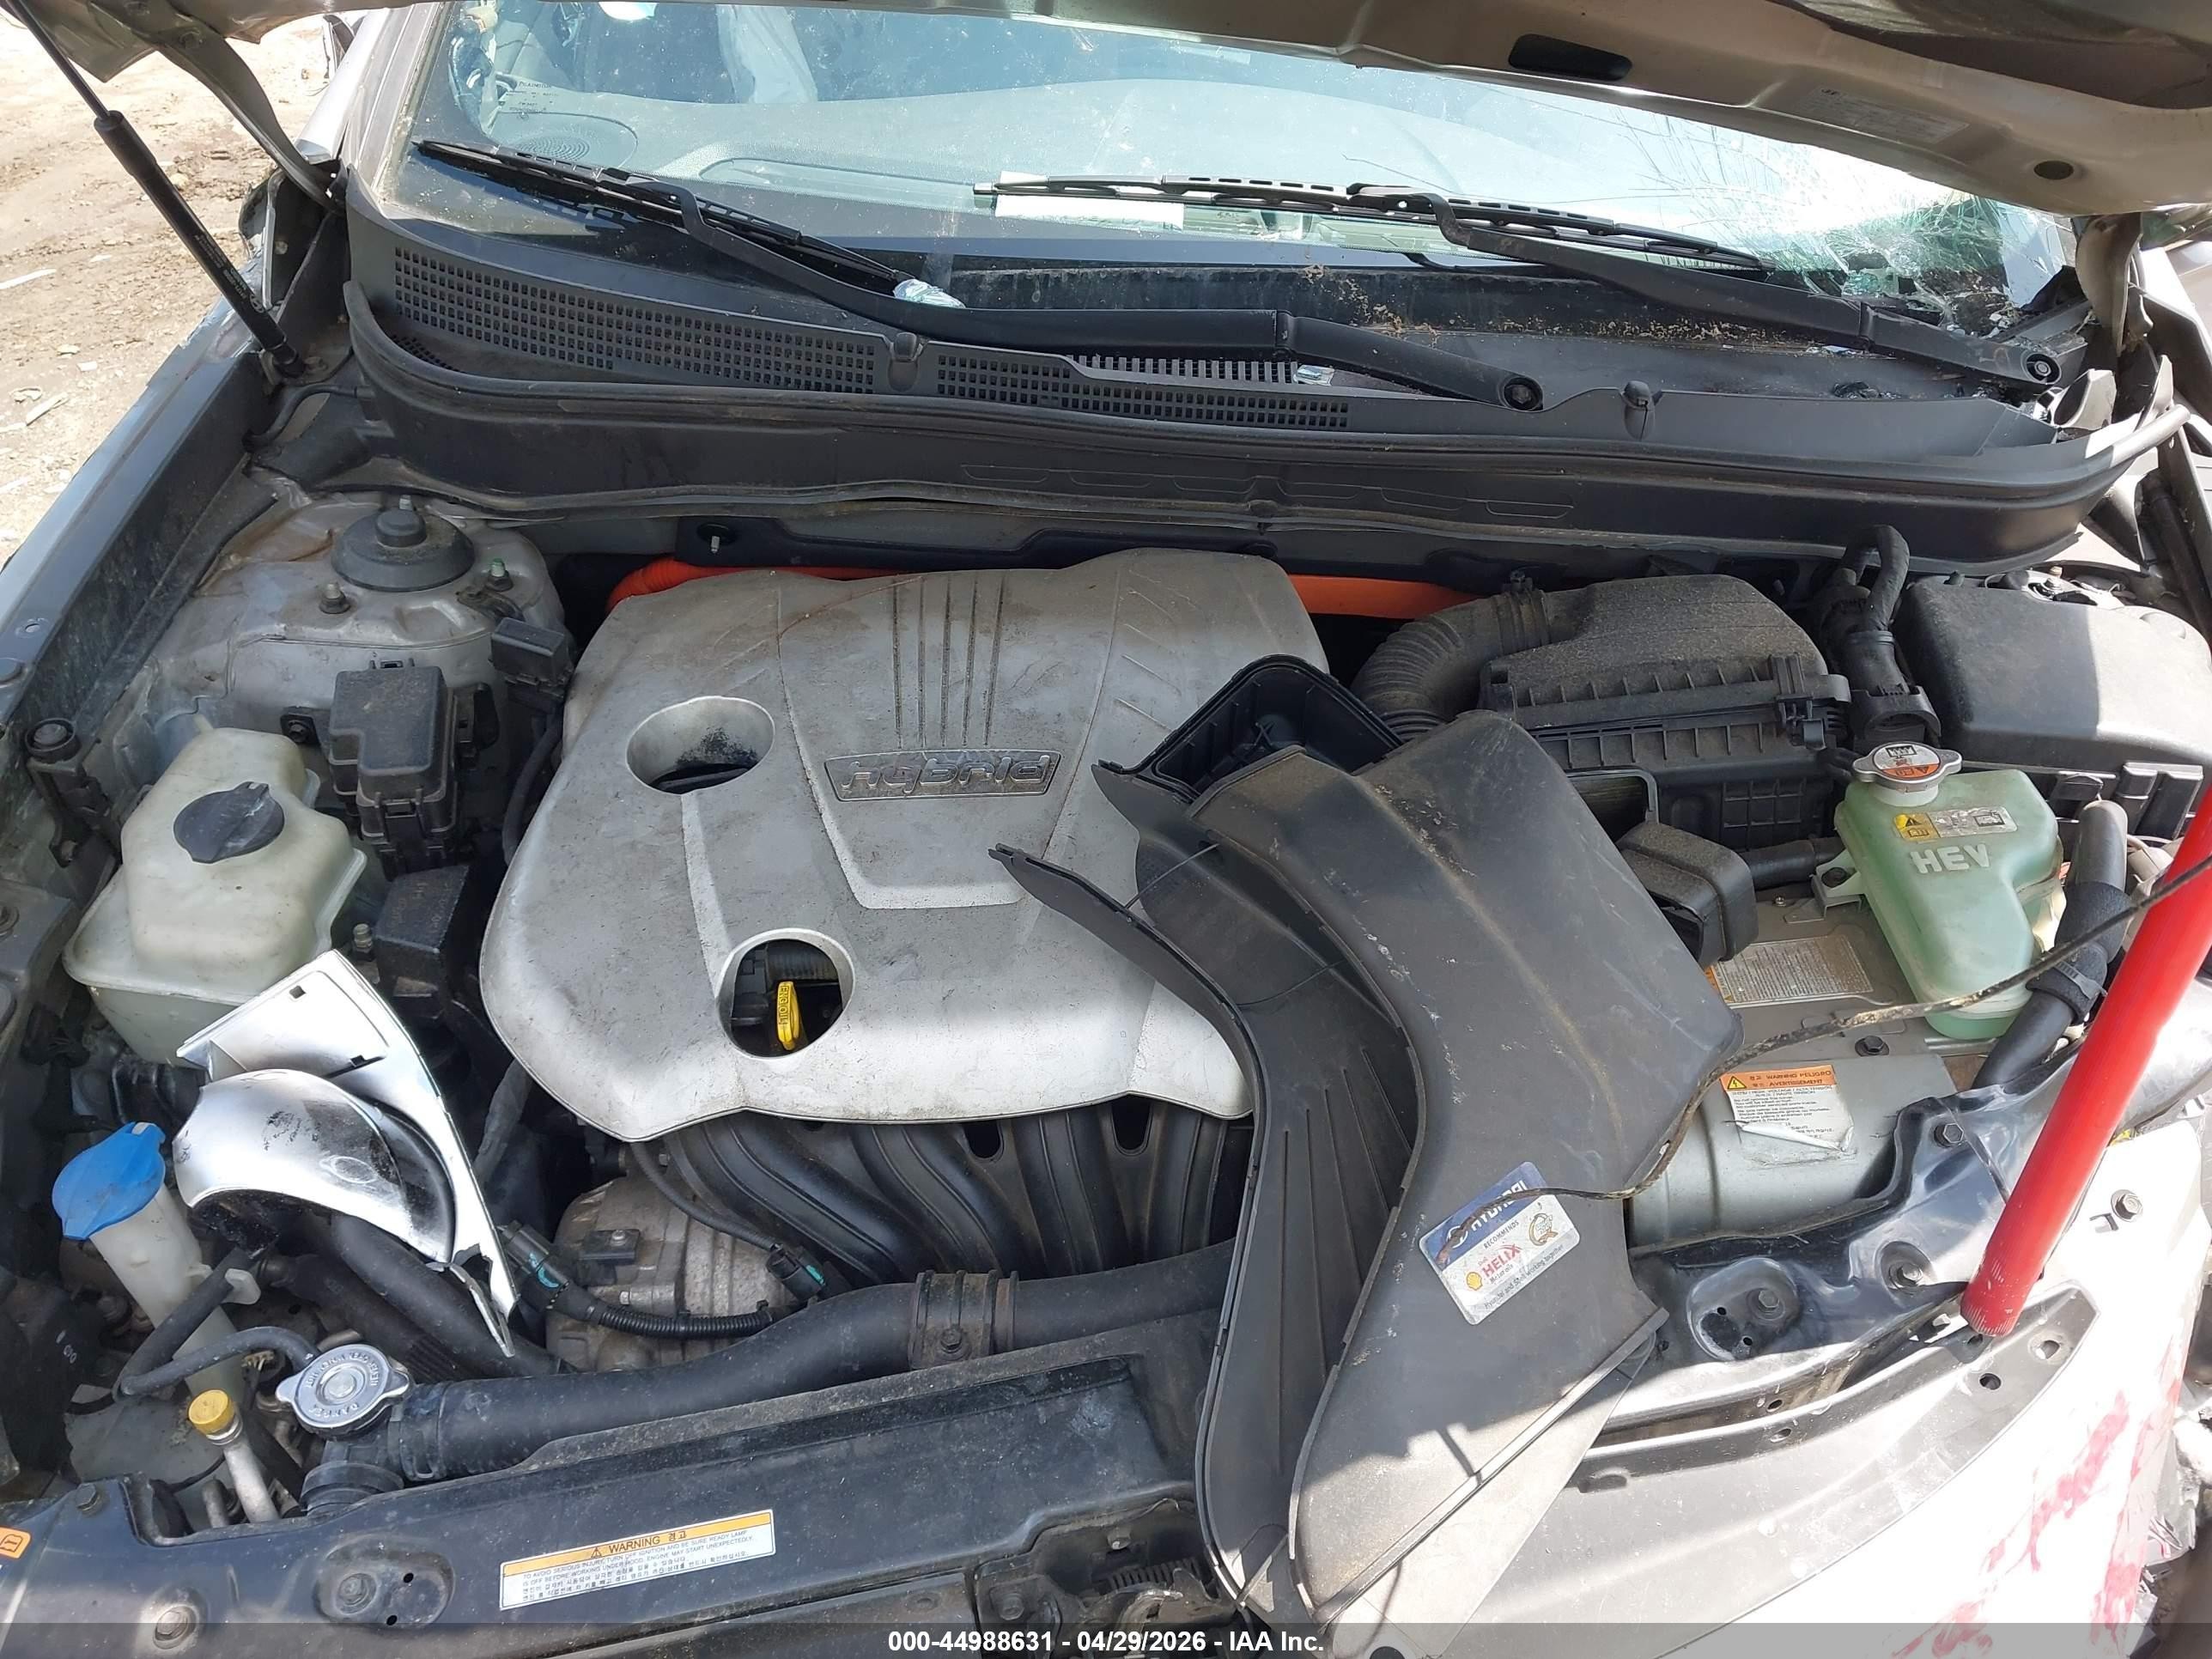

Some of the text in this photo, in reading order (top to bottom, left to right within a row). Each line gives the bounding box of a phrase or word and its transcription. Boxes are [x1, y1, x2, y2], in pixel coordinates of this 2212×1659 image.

[1909, 843, 1990, 874] HEV
[779, 985, 789, 1024] ENG OIL
[1483, 1220, 1519, 1249] RECOMMENDS
[1482, 1243, 1521, 1278] HELIX
[609, 1535, 660, 1554] WARNING
[685, 1545, 703, 1553] START
[532, 1569, 550, 1577] AVOID
[553, 1563, 580, 1573] SERIOUS
